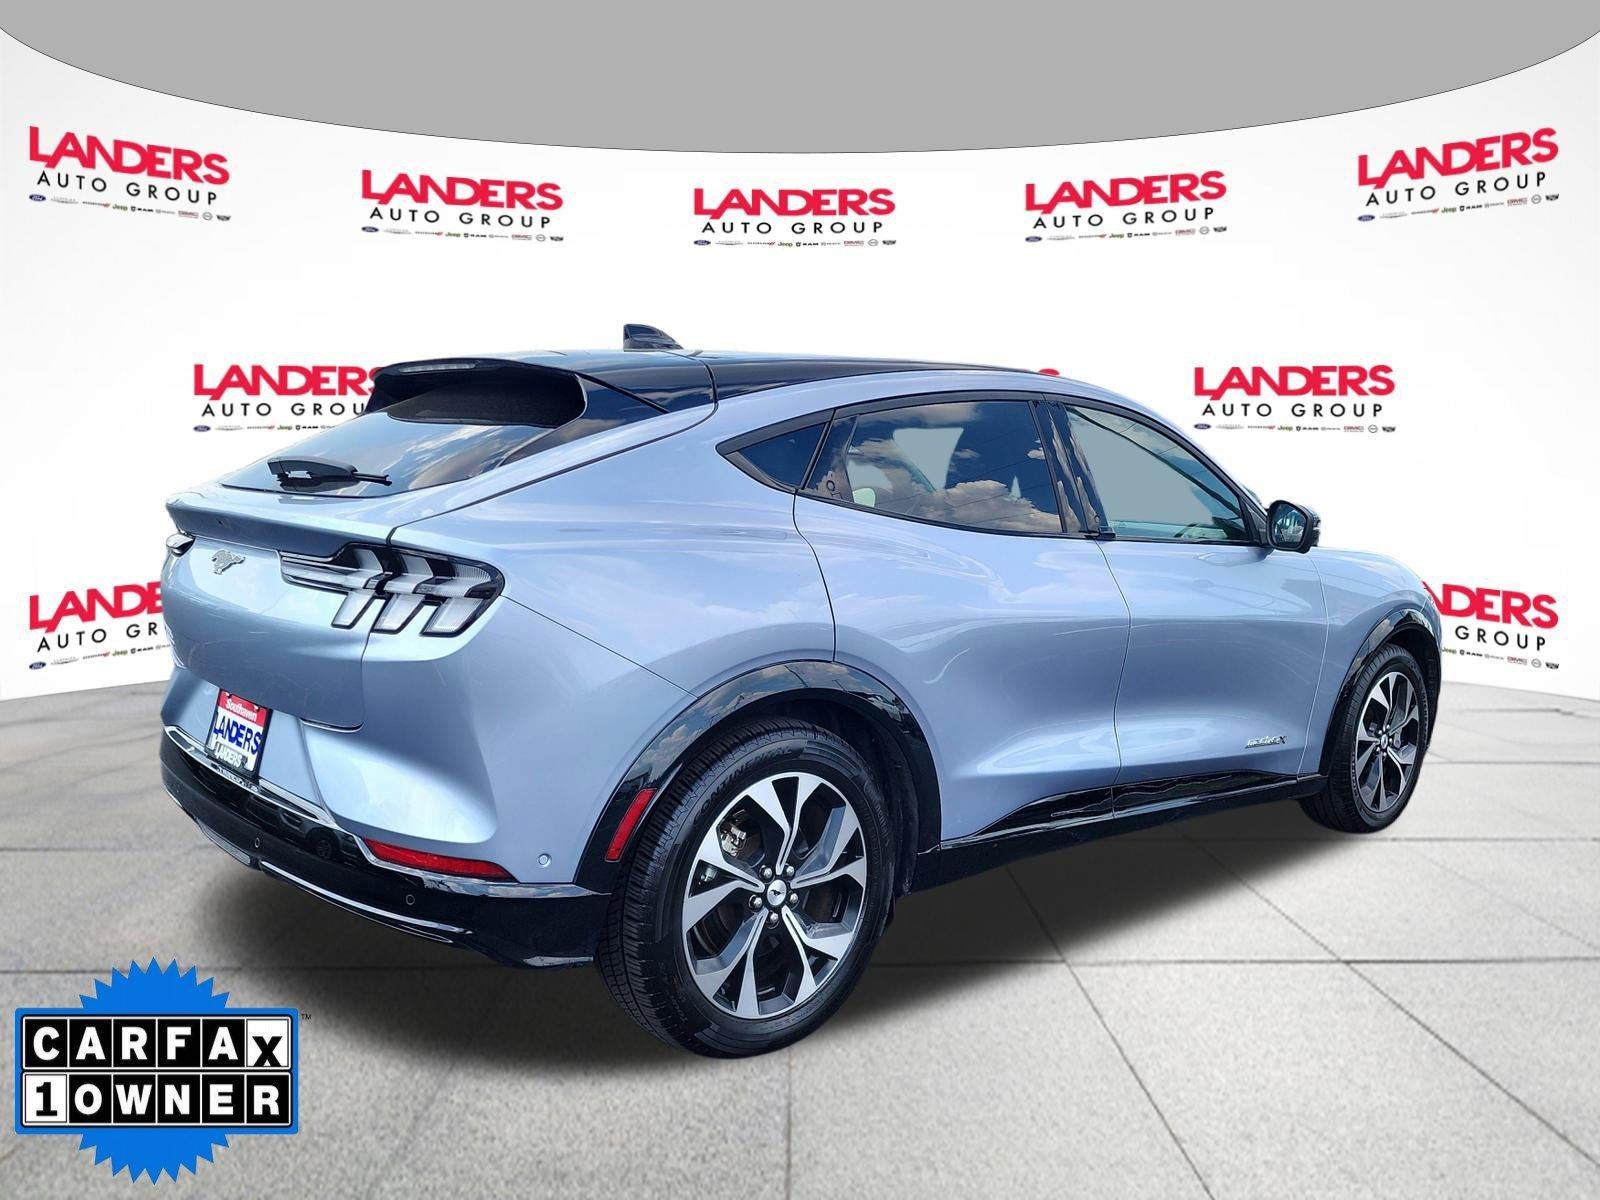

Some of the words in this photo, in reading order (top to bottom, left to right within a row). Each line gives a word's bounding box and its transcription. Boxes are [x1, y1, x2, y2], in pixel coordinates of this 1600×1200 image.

[30, 126, 229, 184] LANDERS
[1359, 128, 1558, 189] LANDERS
[37, 170, 107, 192] AUTO
[126, 182, 217, 205] GROUP
[362, 170, 563, 210] LANDERS
[694, 188, 895, 219] LANDERS
[1026, 171, 1226, 214] LANDERS
[1366, 186, 1436, 206] AUTO
[1455, 172, 1546, 195] GROUP
[370, 207, 440, 223] AUTO
[459, 213, 550, 228] GROUP
[702, 222, 772, 234] AUTO
[791, 222, 883, 234] GROUP
[1033, 214, 1103, 228] AUTO
[1123, 207, 1214, 225] GROUP
[1194, 365, 1395, 400] LANDERS
[202, 403, 271, 417] AUTO
[291, 403, 365, 416] GROU
[1202, 403, 1272, 417] AUTO
[1291, 403, 1383, 417] GROUP
[30, 582, 163, 633] LANDE
[1422, 581, 1558, 629] DERS
[37, 629, 107, 652] AUTO
[1455, 625, 1546, 650] GROUP
[225, 699, 258, 722] Southaven
[213, 709, 263, 755] LANDERS
